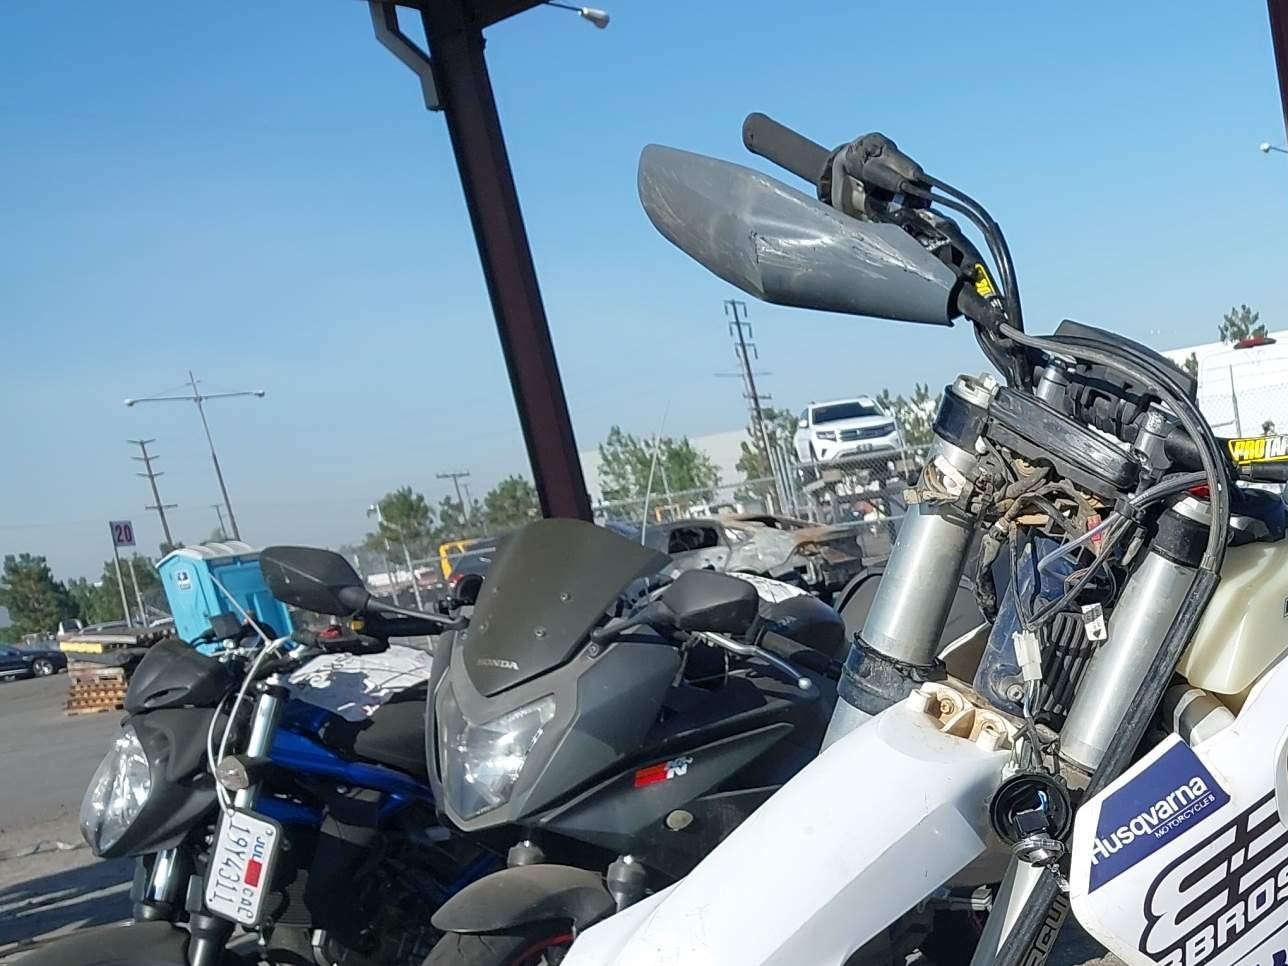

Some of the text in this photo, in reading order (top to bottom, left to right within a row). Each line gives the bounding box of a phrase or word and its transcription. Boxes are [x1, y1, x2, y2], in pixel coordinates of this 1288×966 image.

[115, 524, 132, 543] 20
[1091, 776, 1208, 865] Husqvarna
[1154, 793, 1215, 839] MOTORCYCLES
[213, 823, 250, 903] 19Y4311
[253, 836, 265, 858] JUL
